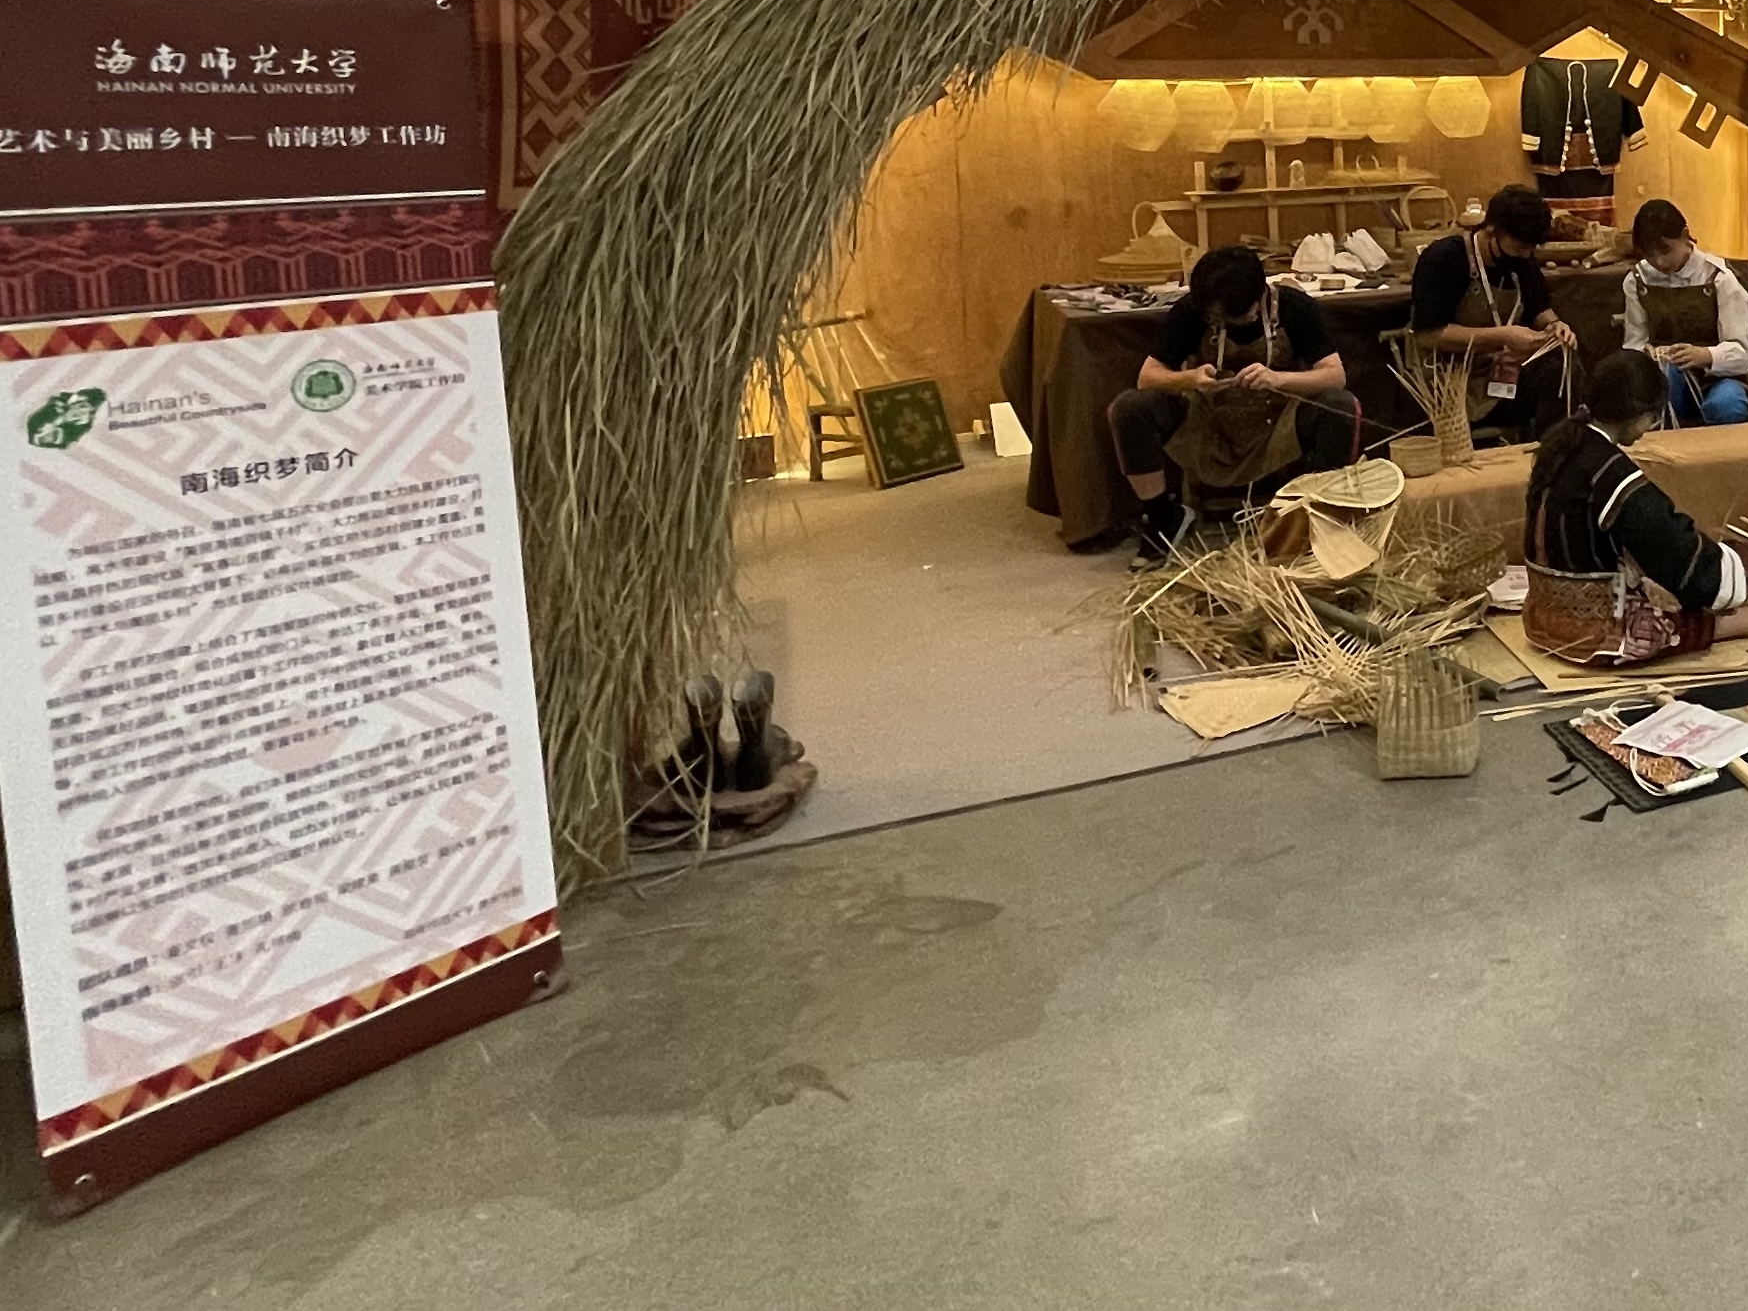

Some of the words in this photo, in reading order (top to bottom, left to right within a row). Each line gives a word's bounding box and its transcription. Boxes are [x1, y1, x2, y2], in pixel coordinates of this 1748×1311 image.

[95, 39, 356, 79] 海南师范大学
[97, 81, 174, 93] HAINAN
[180, 81, 258, 94] NORMAL
[263, 82, 357, 94] UNIVERSITY
[180, 447, 359, 495] 南海织梦简介
